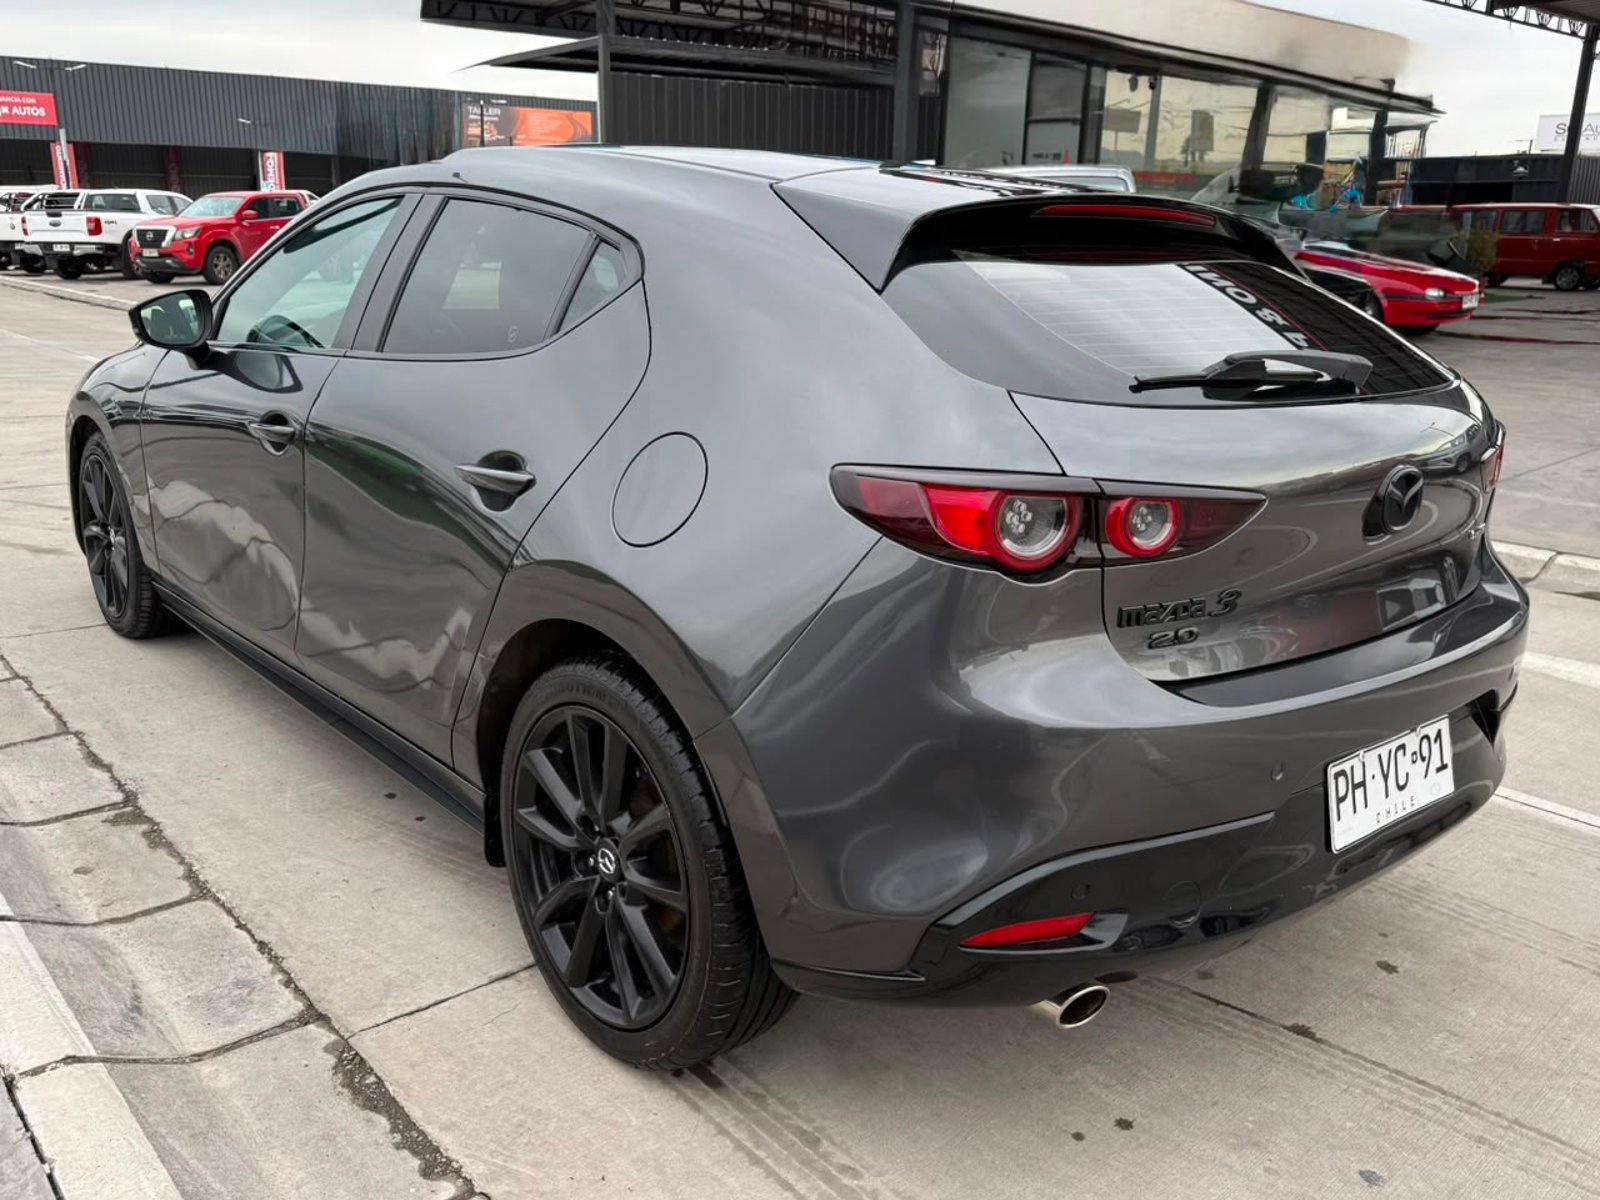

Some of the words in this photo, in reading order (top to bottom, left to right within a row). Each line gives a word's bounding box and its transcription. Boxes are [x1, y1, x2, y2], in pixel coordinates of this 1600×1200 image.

[12, 105, 46, 117] AUTOS
[467, 105, 501, 116] TALER
[1117, 597, 1206, 628] mazda
[1207, 588, 1243, 617] 3
[1375, 795, 1416, 824] CHILE
